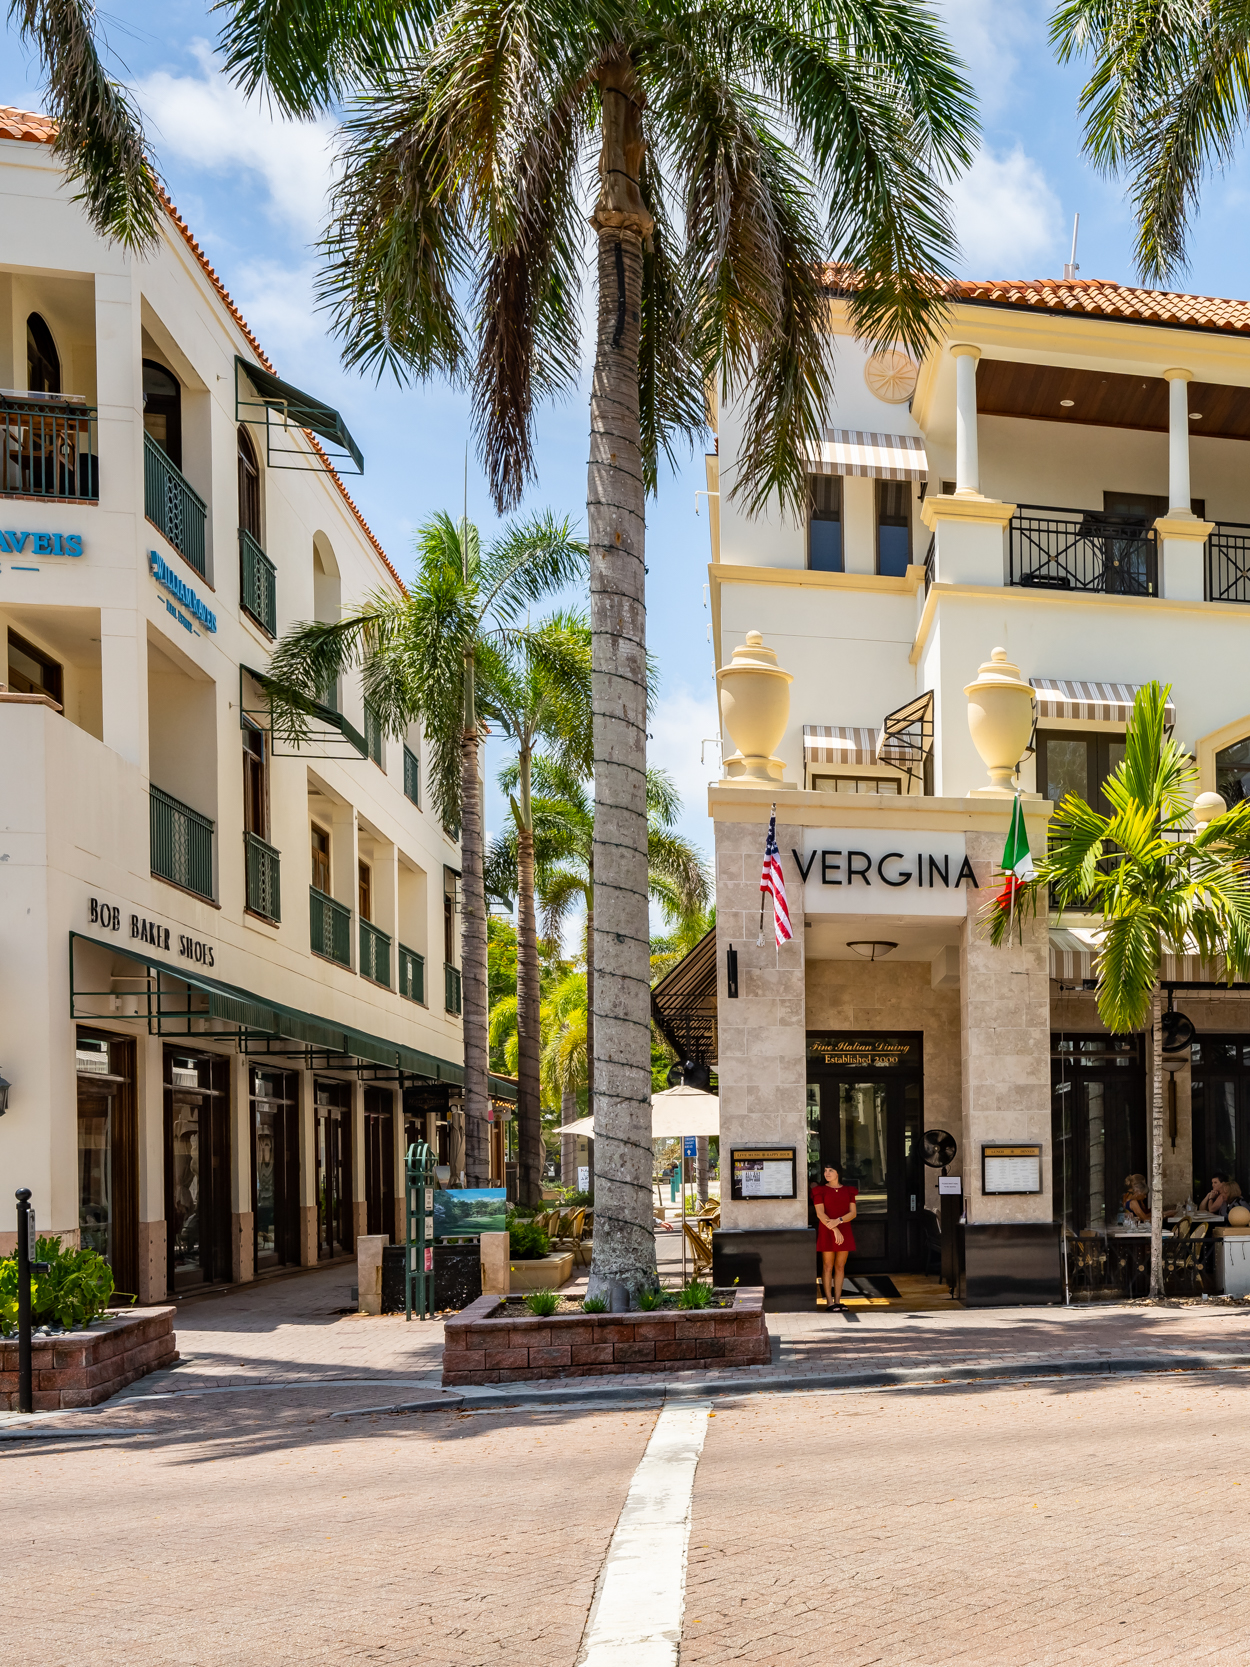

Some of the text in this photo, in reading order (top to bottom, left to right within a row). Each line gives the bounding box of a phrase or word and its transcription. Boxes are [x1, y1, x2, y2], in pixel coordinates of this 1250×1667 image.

[151, 551, 198, 613] WILLIAM
[166, 599, 193, 634] REAL ESTATE
[791, 849, 979, 888] VERGINA
[90, 898, 215, 967] BOB BAKER SHOES
[809, 1041, 910, 1054] Fine Italian Dining
[825, 1054, 899, 1064] Established 2000
